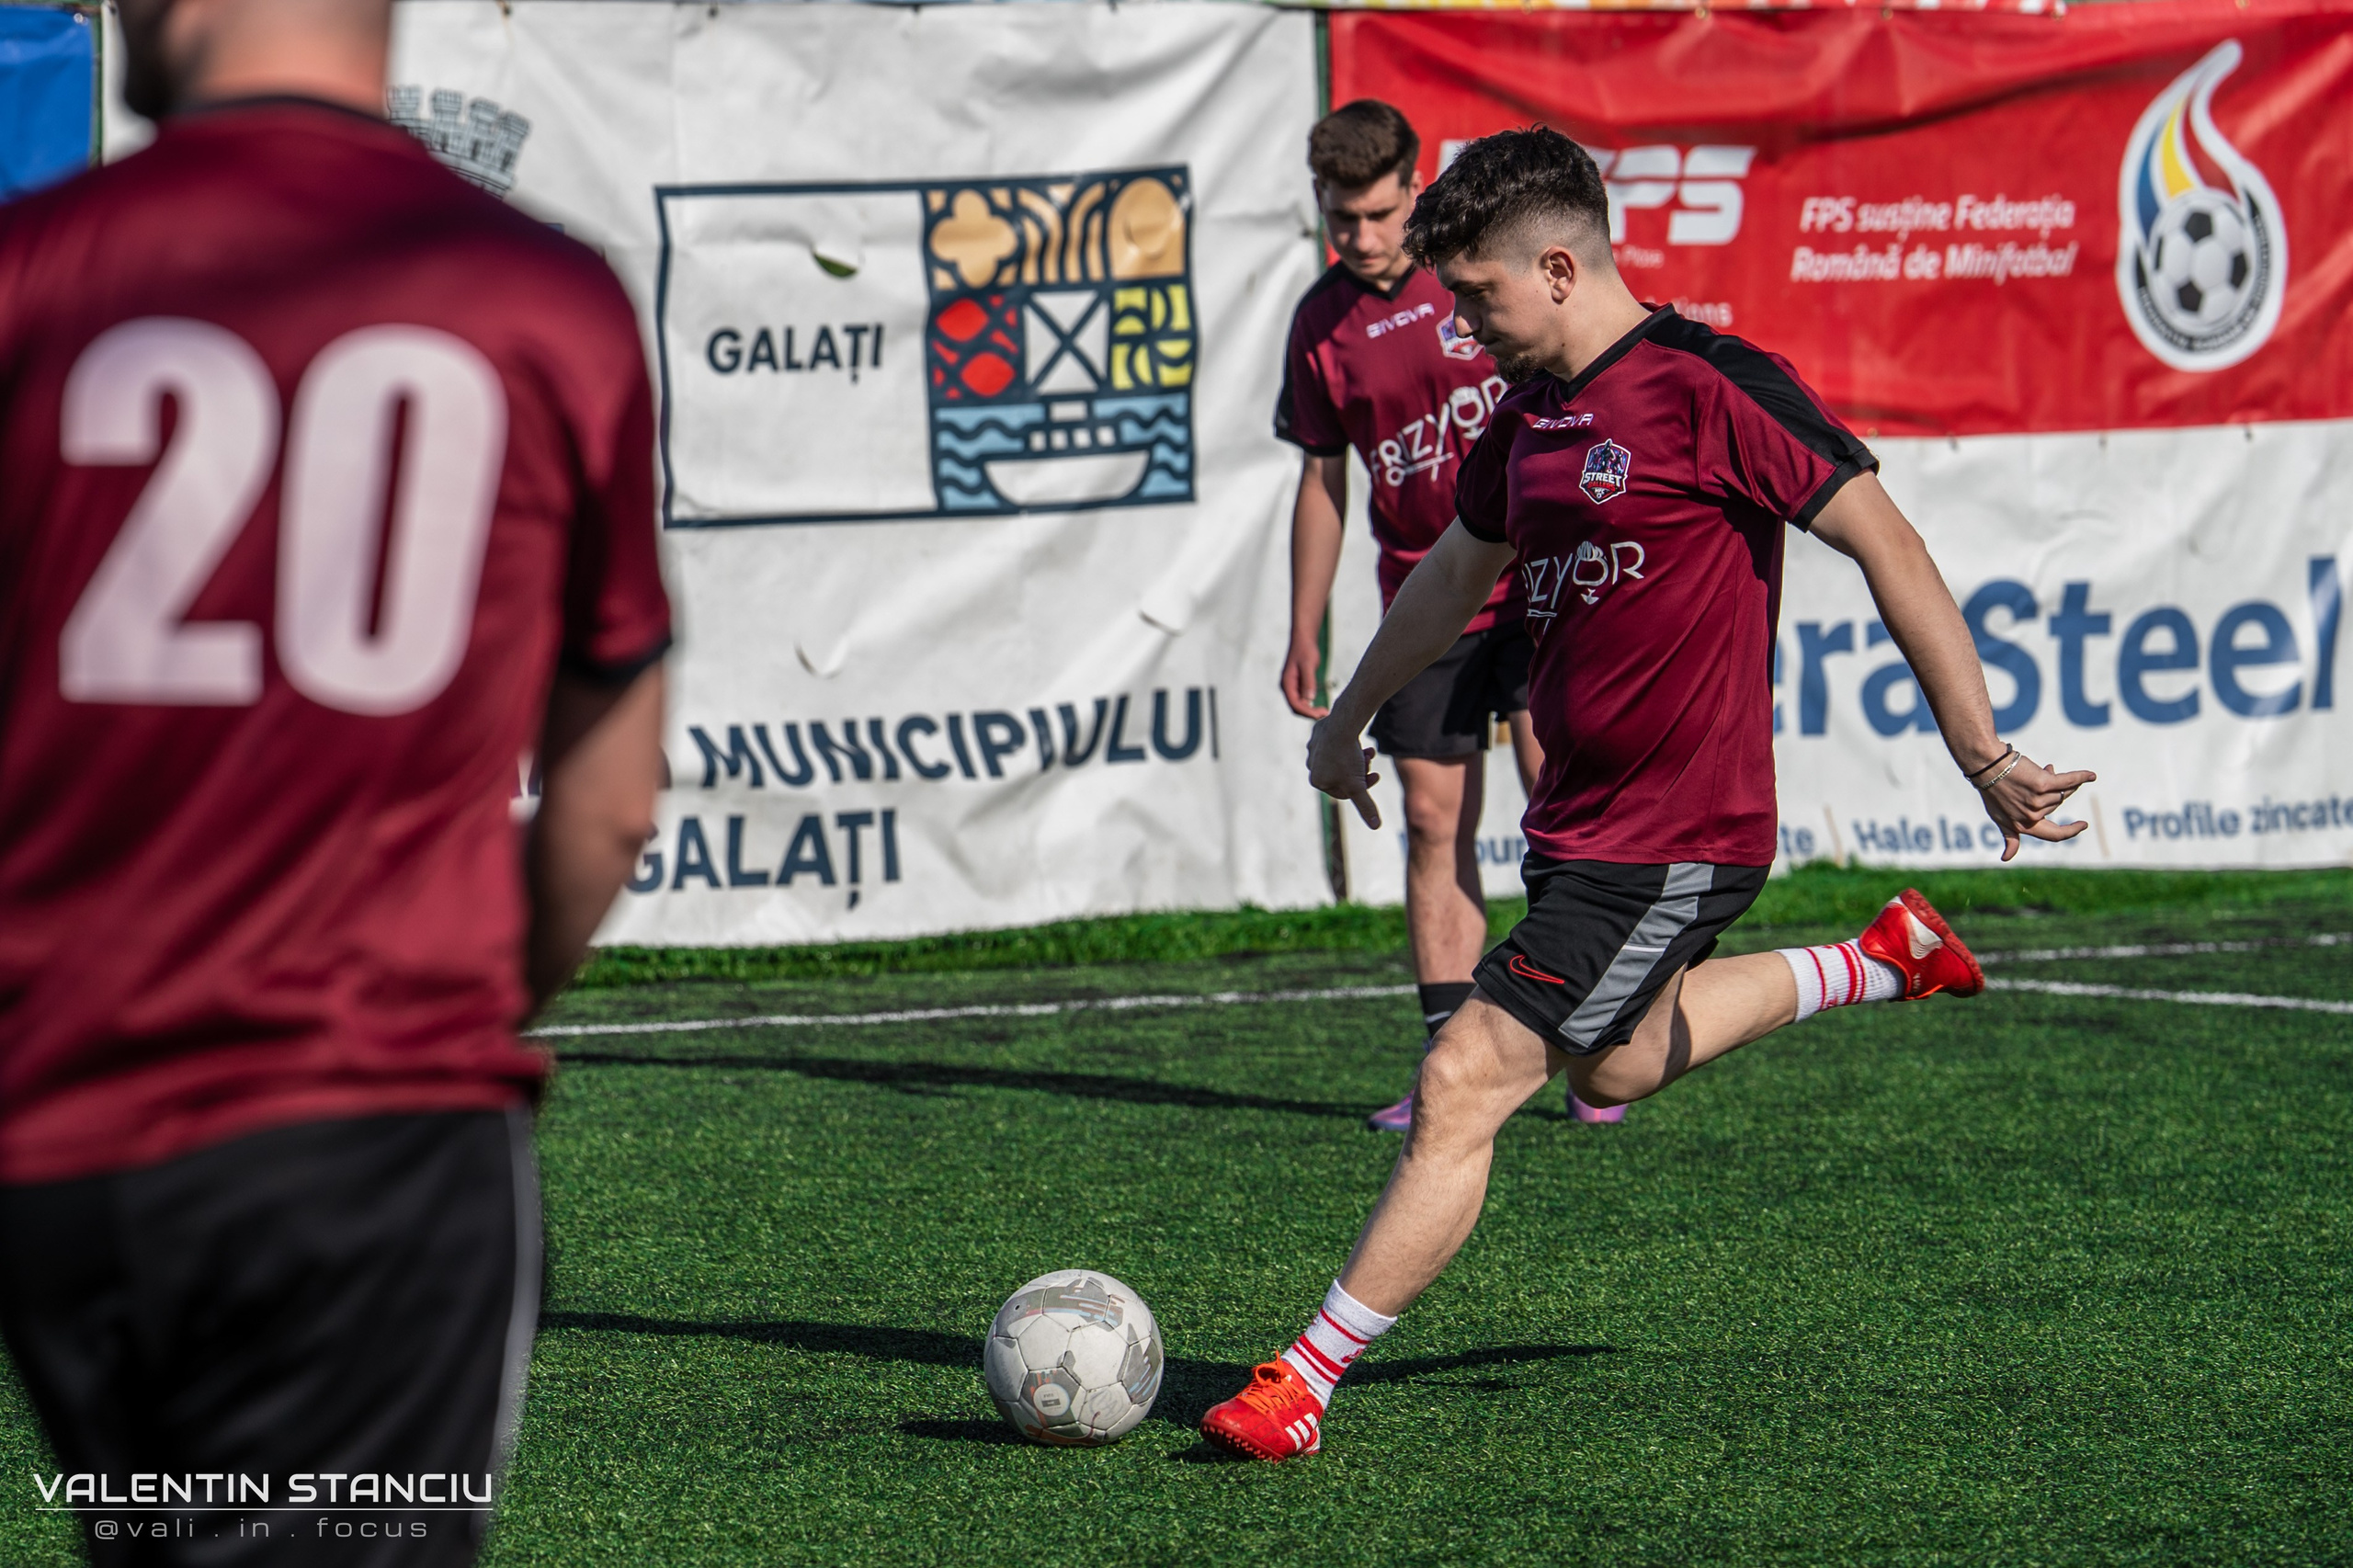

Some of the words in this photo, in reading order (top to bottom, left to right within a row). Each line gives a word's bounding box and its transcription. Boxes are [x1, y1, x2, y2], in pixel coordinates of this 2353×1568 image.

[1588, 143, 1756, 246] PS
[1800, 196, 1857, 233] FPS
[1954, 193, 2076, 240] Federația
[1790, 244, 1901, 283] Română
[1903, 244, 1943, 280] de
[1944, 240, 2081, 287] Minifotbal
[707, 323, 885, 384] GALAȚI
[1532, 413, 1594, 429] GIVOVA
[1583, 472, 1621, 487] STREET
[58, 315, 510, 719] 20
[1522, 540, 1645, 634] IZYOR
[1774, 556, 2342, 736] raSteel
[688, 686, 1219, 790] MUNICIPIULUI
[1851, 812, 1933, 853] Hale
[1938, 814, 1972, 851] la
[2123, 800, 2241, 841] Profile
[626, 807, 900, 911] GALAȚI
